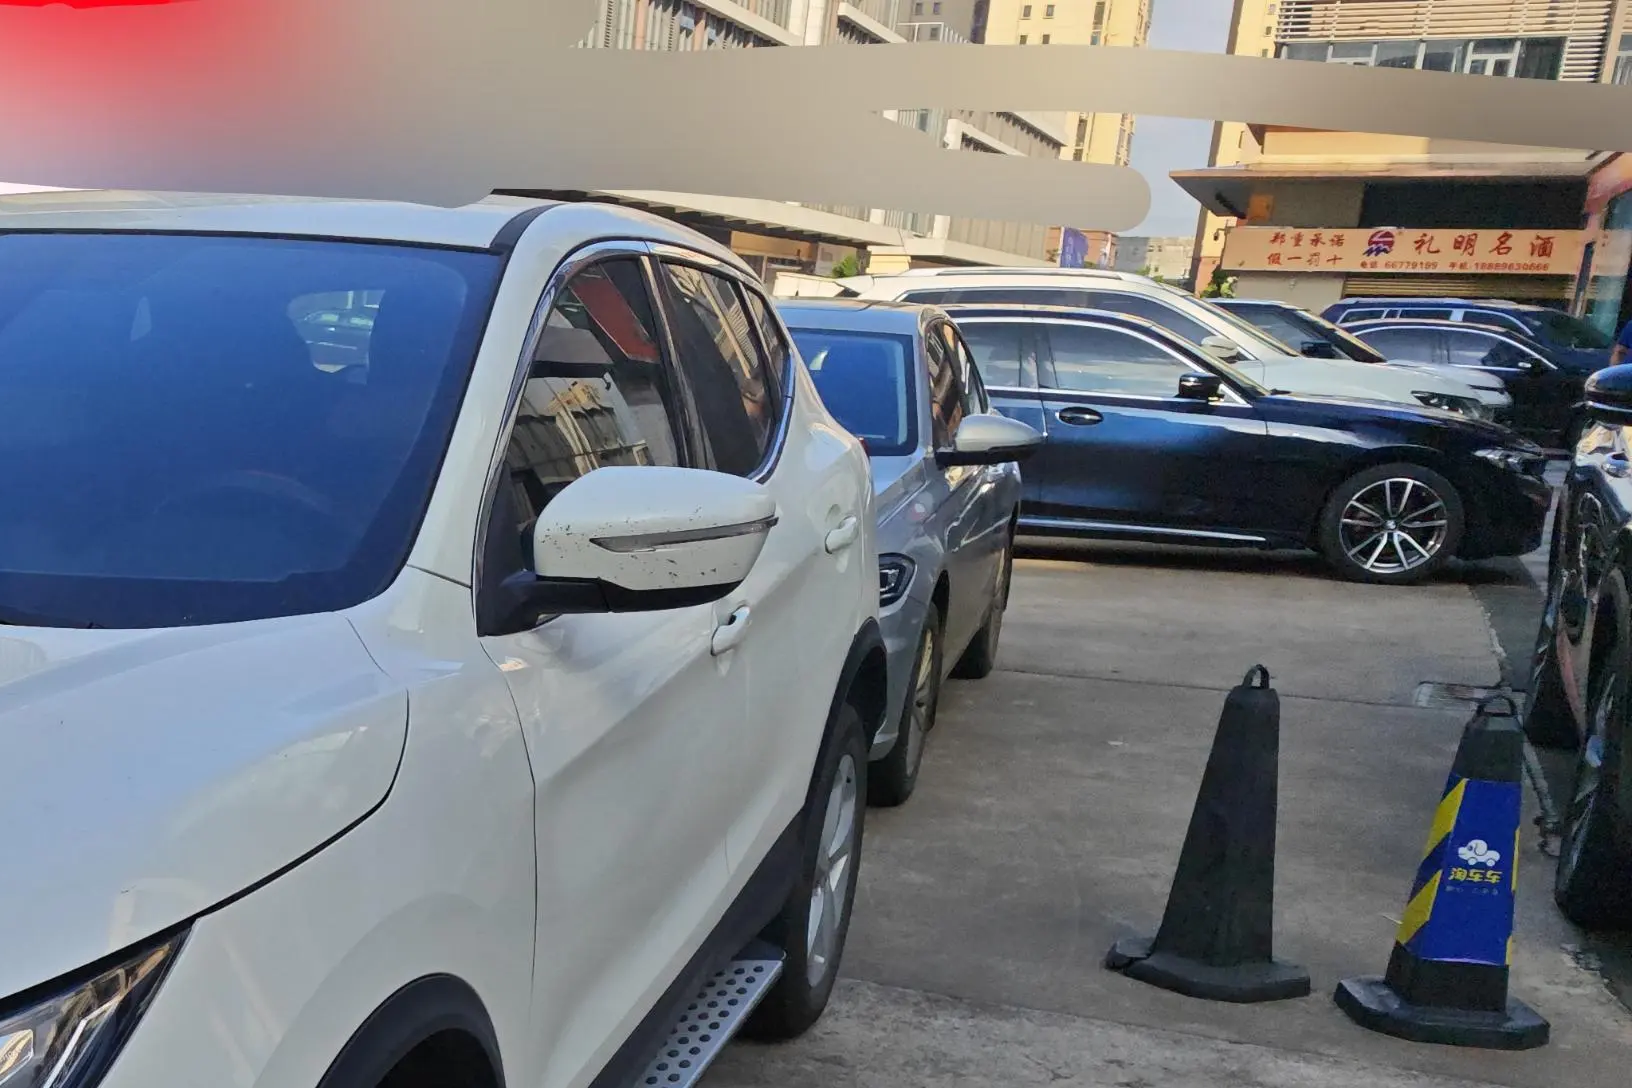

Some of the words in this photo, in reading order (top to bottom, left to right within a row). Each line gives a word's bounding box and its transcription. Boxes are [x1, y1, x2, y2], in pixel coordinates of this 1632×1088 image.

[1269, 231, 1345, 247] 郑重承诺
[1414, 231, 1556, 258] 礼明名酒
[1267, 252, 1344, 267] 假一罚十
[1448, 867, 1503, 884] 淘车车
